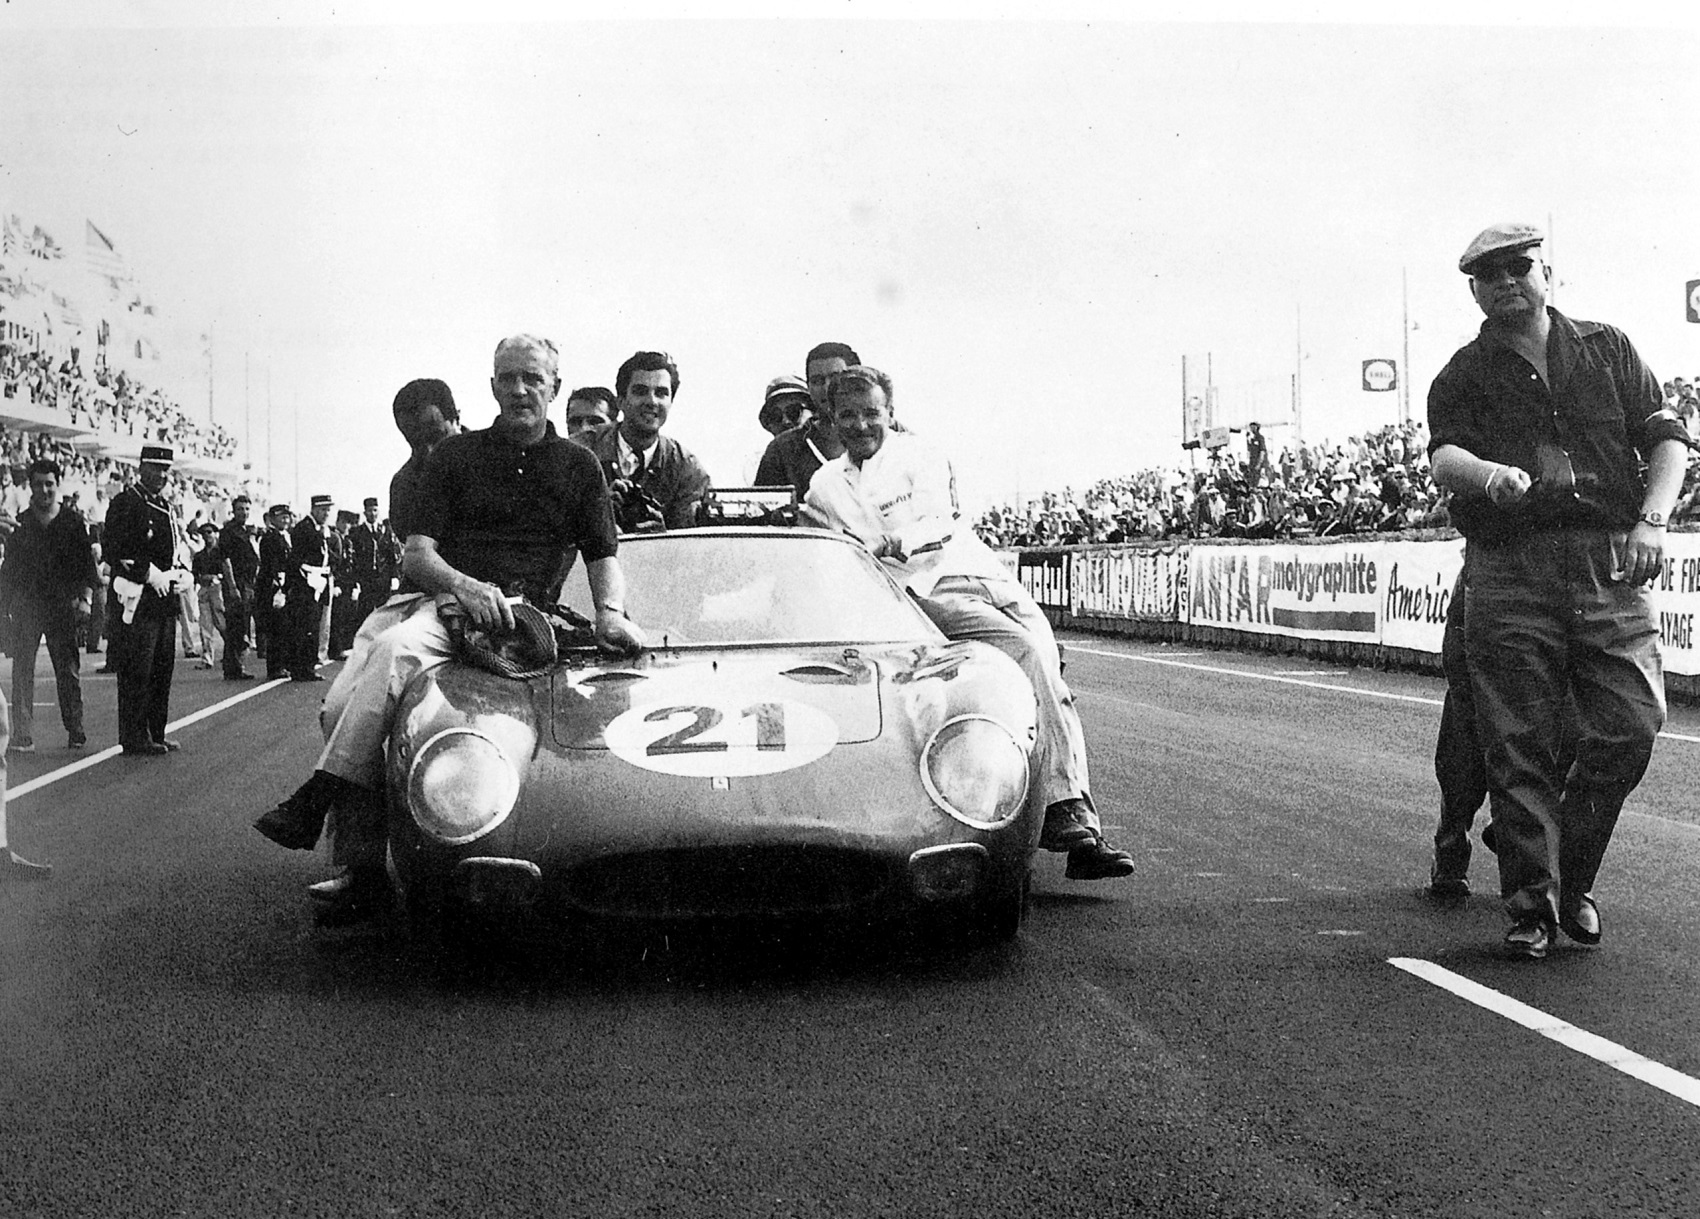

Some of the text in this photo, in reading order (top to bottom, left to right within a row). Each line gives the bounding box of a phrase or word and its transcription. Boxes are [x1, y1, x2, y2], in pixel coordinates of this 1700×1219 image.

[1193, 554, 1271, 625] ANTAR
[1273, 552, 1377, 602] molygraphite
[1660, 558, 1675, 592] DE
[644, 703, 786, 756] 21
